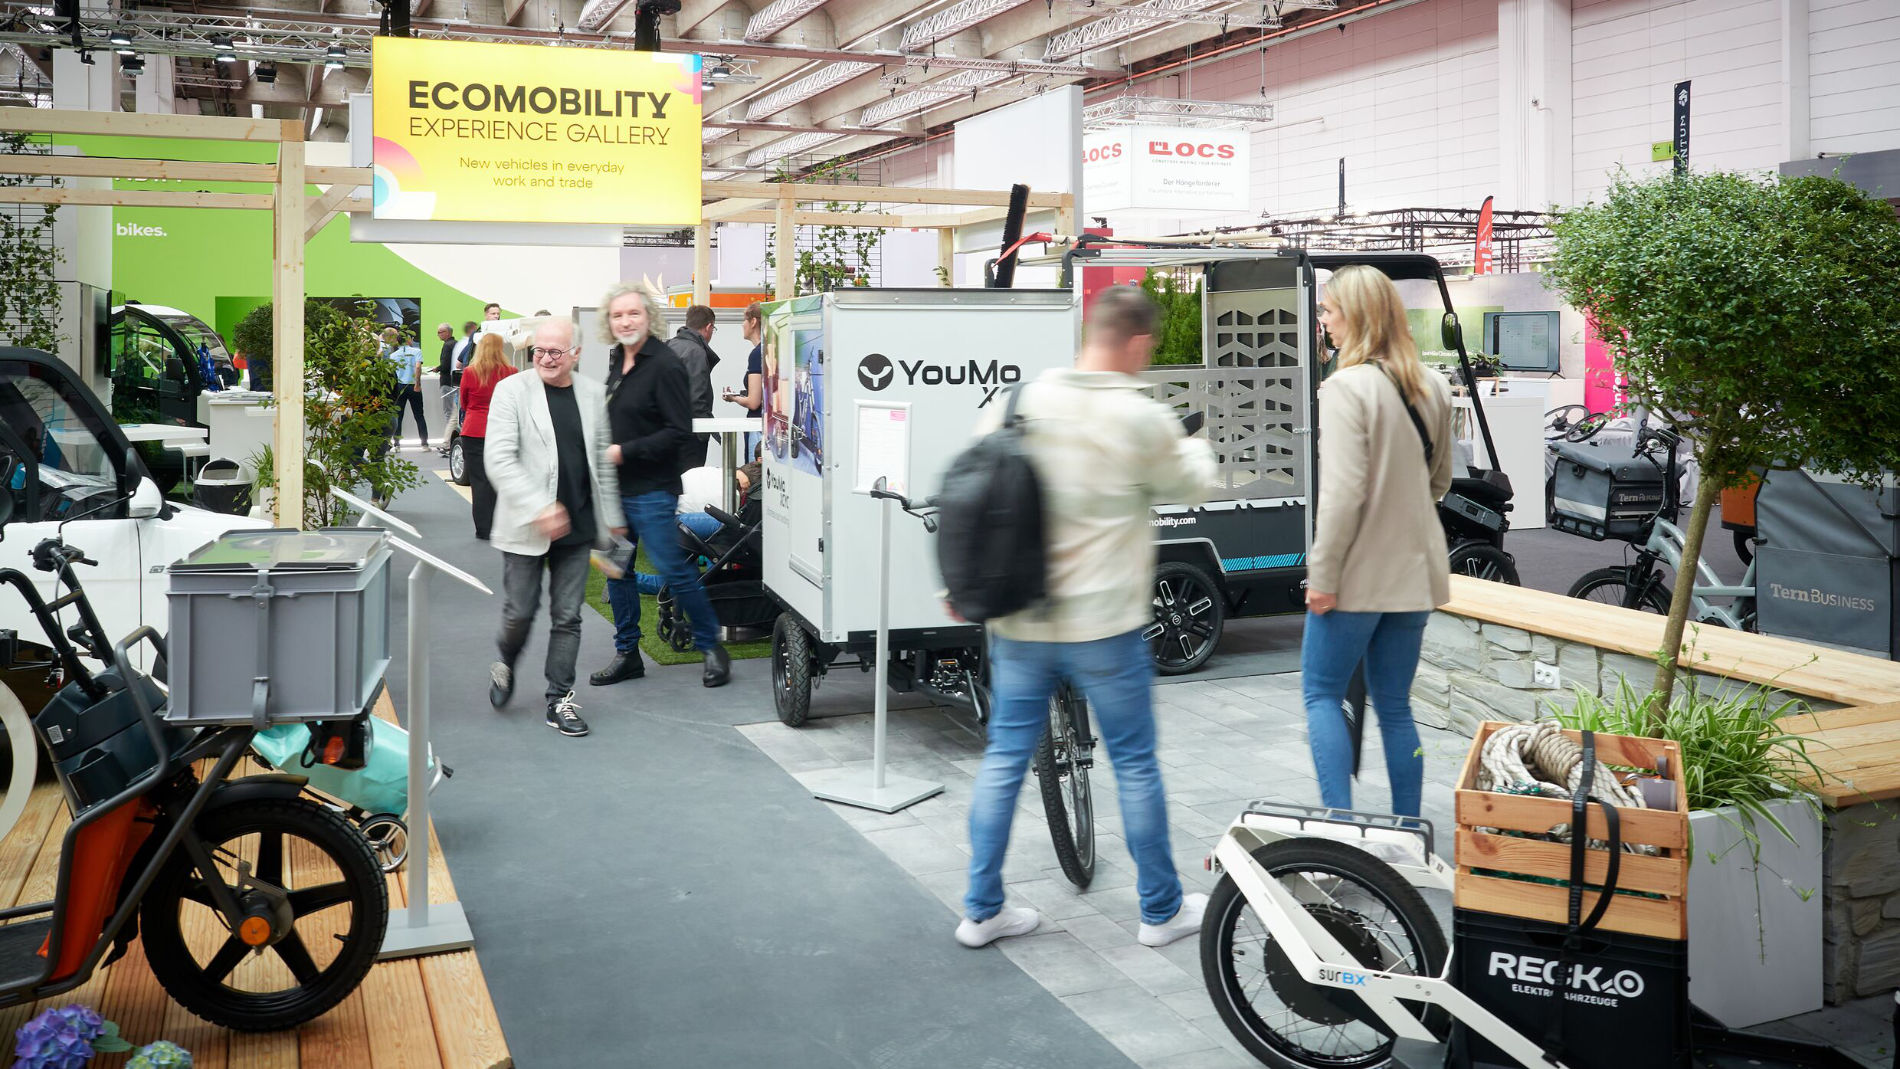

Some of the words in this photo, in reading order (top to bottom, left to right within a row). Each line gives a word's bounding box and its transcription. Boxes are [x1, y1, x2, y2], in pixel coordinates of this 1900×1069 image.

[408, 80, 671, 119] ECOMOBILITY
[409, 117, 558, 142] EXPERIENCE
[566, 123, 670, 146] GALLERY
[459, 157, 490, 170] New
[494, 157, 548, 171] vehicles
[552, 160, 563, 171] in
[567, 161, 625, 175] everyday
[493, 175, 526, 187] work
[530, 176, 555, 188] and
[559, 177, 593, 189] trade
[116, 222, 168, 237] bikes.
[898, 359, 1021, 386] YouMo
